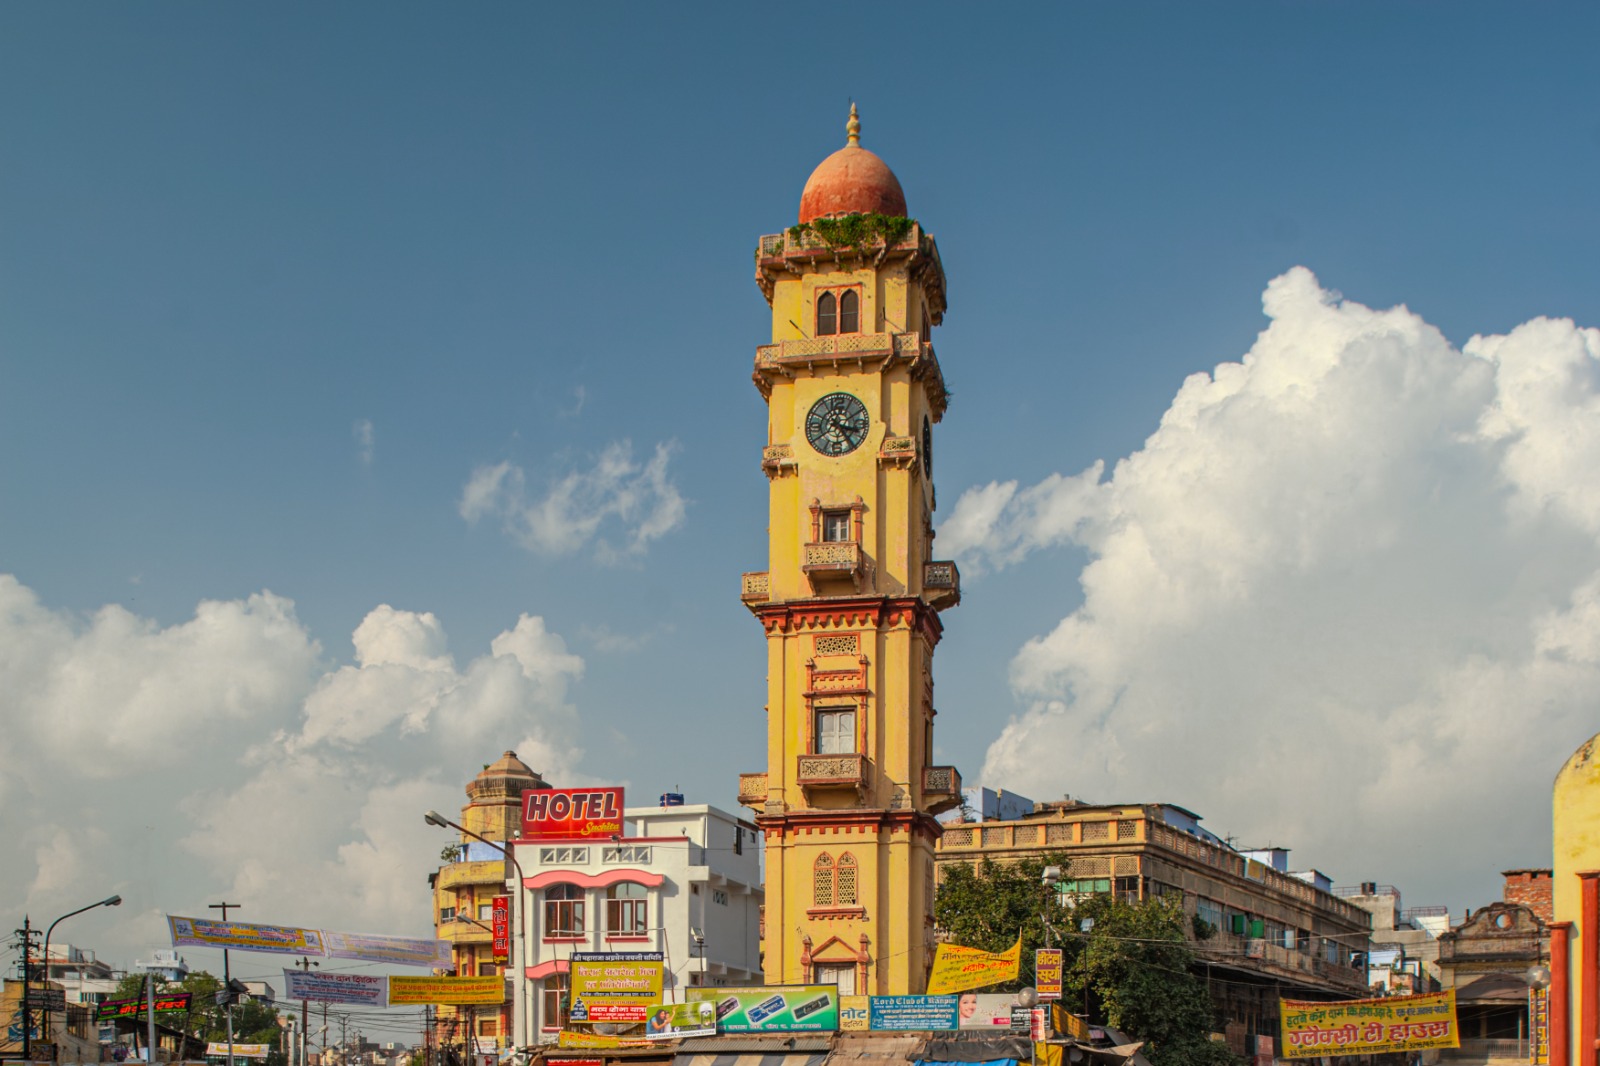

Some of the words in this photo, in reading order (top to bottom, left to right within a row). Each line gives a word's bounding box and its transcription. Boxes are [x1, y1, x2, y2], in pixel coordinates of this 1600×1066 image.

[526, 792, 618, 822] HOTEL
[580, 822, 620, 836] Suchita
[494, 907, 508, 950] होटल
[1038, 952, 1060, 965] होटल
[928, 997, 957, 1005] Kanpur
[841, 1008, 867, 1019] नोट
[1287, 1010, 1306, 1028] इतने
[1364, 1022, 1384, 1043] टी
[1389, 1020, 1450, 1042] हाउस
